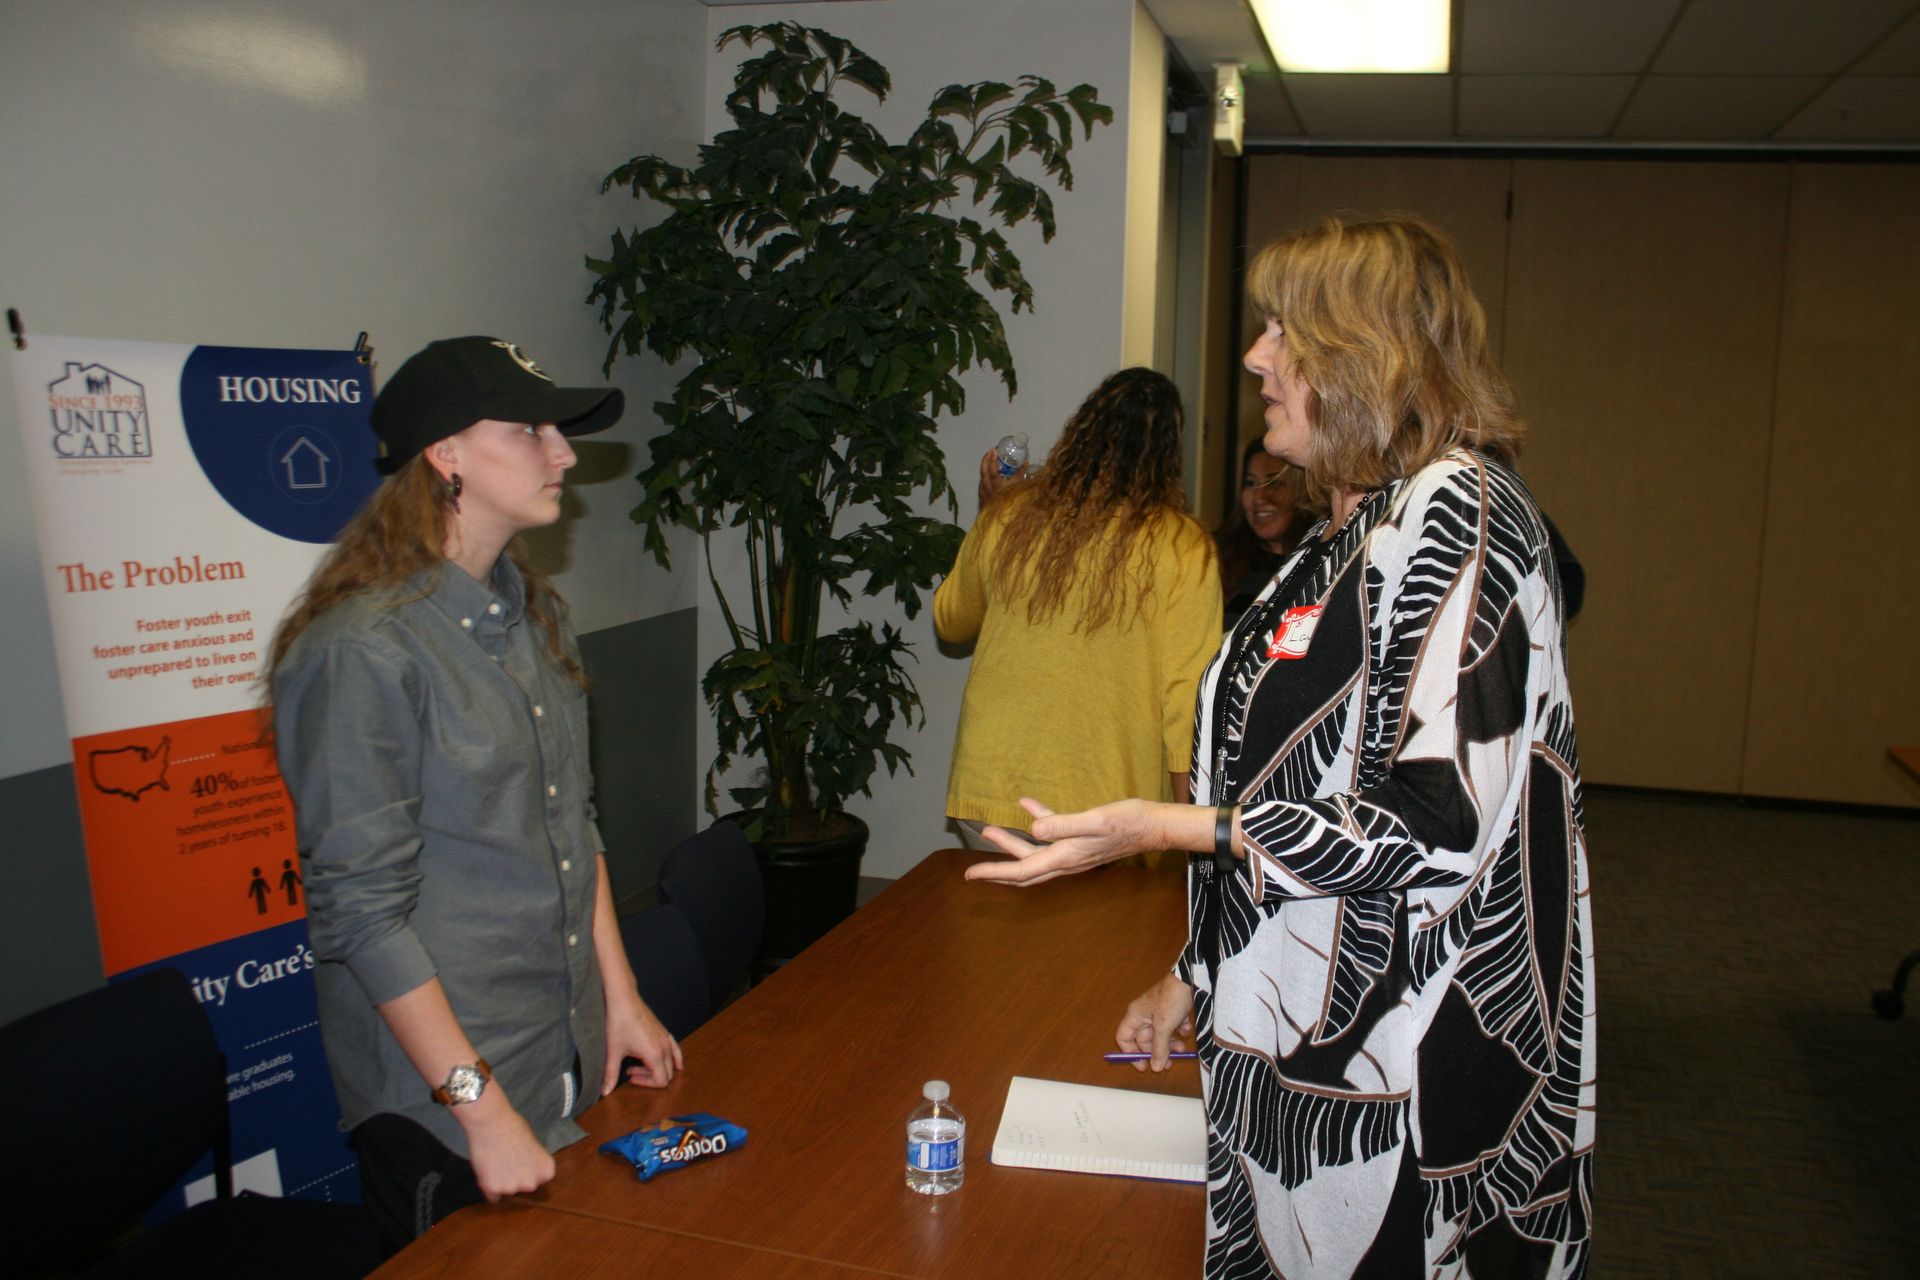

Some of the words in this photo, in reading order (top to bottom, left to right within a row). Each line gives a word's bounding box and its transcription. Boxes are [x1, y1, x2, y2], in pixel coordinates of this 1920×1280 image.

[50, 395, 97, 409] SINCE
[219, 376, 361, 404] HOUSING
[51, 409, 144, 434] UNITY
[54, 433, 145, 456] CARE
[57, 562, 114, 593] The
[122, 555, 246, 588] Problem
[136, 618, 181, 632] Foster
[185, 611, 224, 631] youth
[227, 609, 252, 623] exit
[93, 643, 136, 659] foster
[140, 641, 169, 654] care
[173, 633, 226, 650] anxious
[229, 628, 254, 642] and
[108, 656, 193, 680] unprepared
[195, 655, 210, 668] to
[213, 652, 237, 666] live
[239, 650, 257, 663] on
[191, 673, 224, 689] their
[227, 670, 258, 684] own.
[189, 771, 239, 798] 40%
[238, 776, 250, 789] of
[192, 800, 225, 818] youth
[227, 790, 283, 808] experience
[176, 813, 252, 836] homelessness
[189, 838, 217, 855] years
[218, 832, 230, 845] of
[231, 826, 270, 842] turning
[241, 1053, 293, 1081] graduates
[251, 1068, 297, 1092] housing.
[659, 1133, 727, 1164] Doritos
